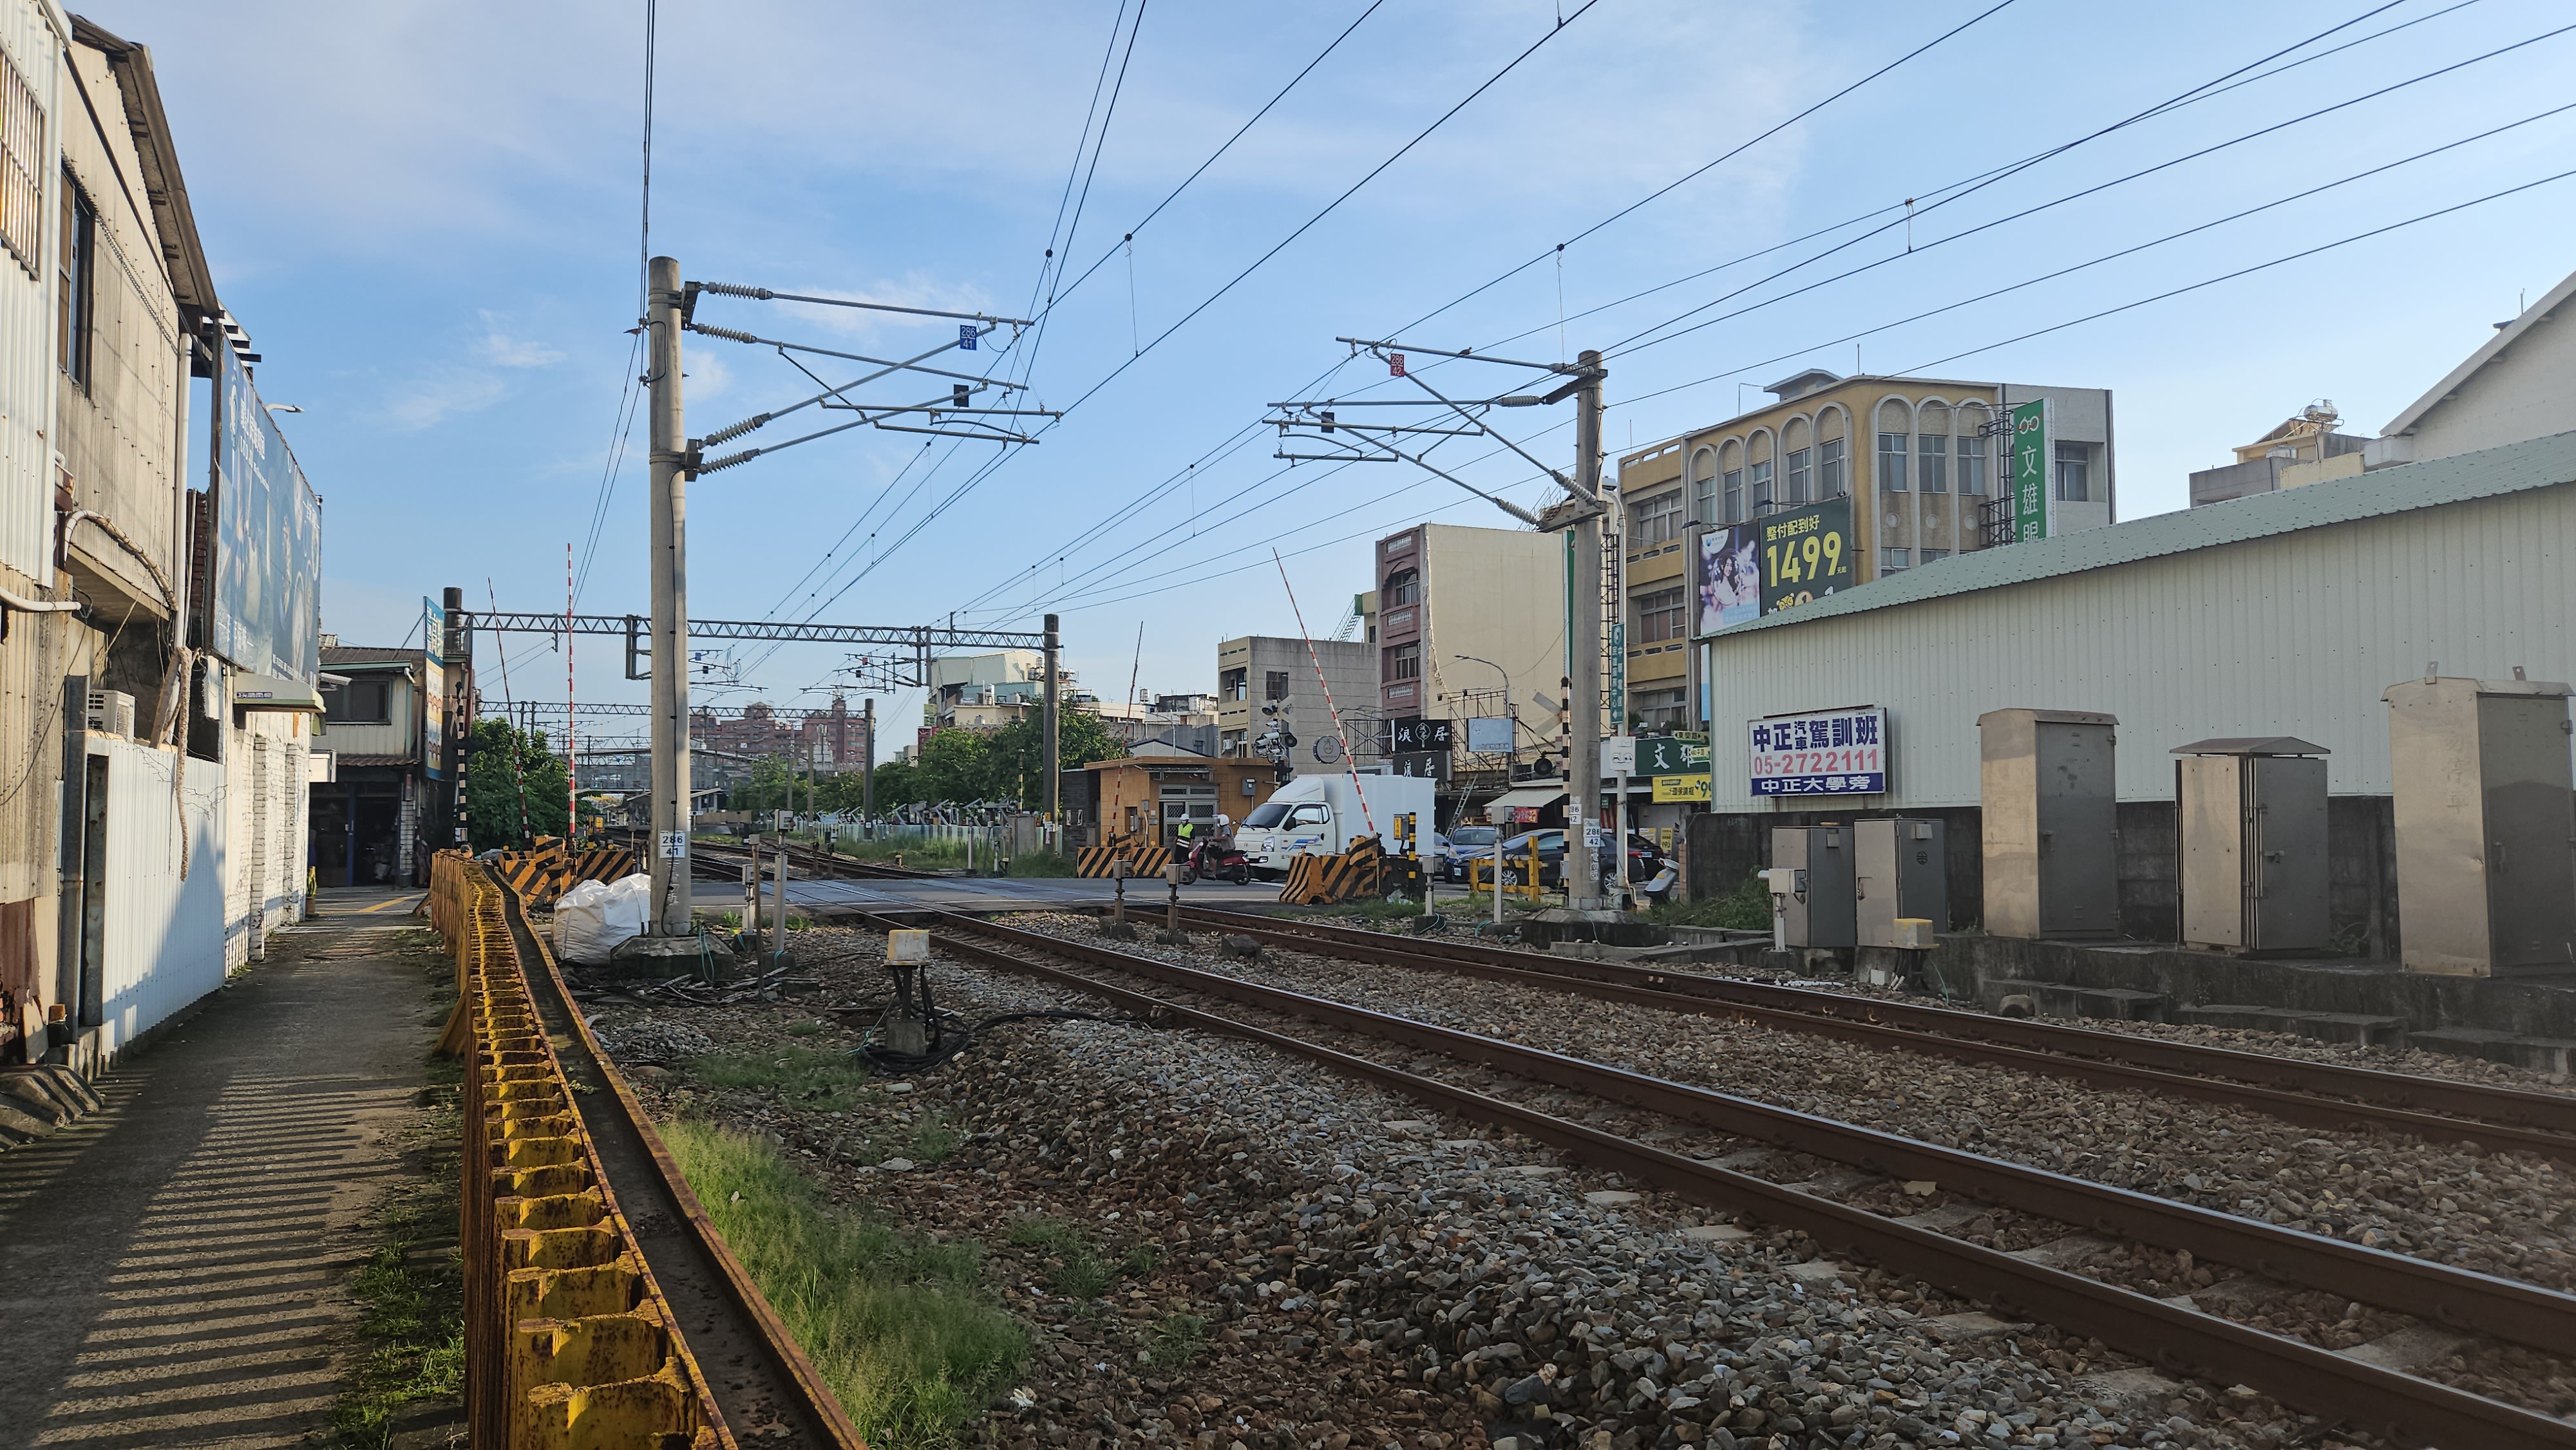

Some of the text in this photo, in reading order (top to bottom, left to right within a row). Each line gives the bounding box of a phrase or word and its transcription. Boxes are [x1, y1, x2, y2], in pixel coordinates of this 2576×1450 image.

[961, 326, 976, 337] 286
[963, 339, 973, 349] 41
[1391, 354, 1403, 364] 286
[1392, 366, 1401, 376] 42
[1766, 514, 1820, 541] 整付配到好
[1767, 531, 1841, 587] 1499
[1753, 715, 1878, 752] 中正汽車駕訓班
[1754, 749, 1877, 775] 05-2722111
[1761, 775, 1870, 793] 中正大學旁
[662, 836, 683, 844] 286
[666, 847, 678, 856] 41
